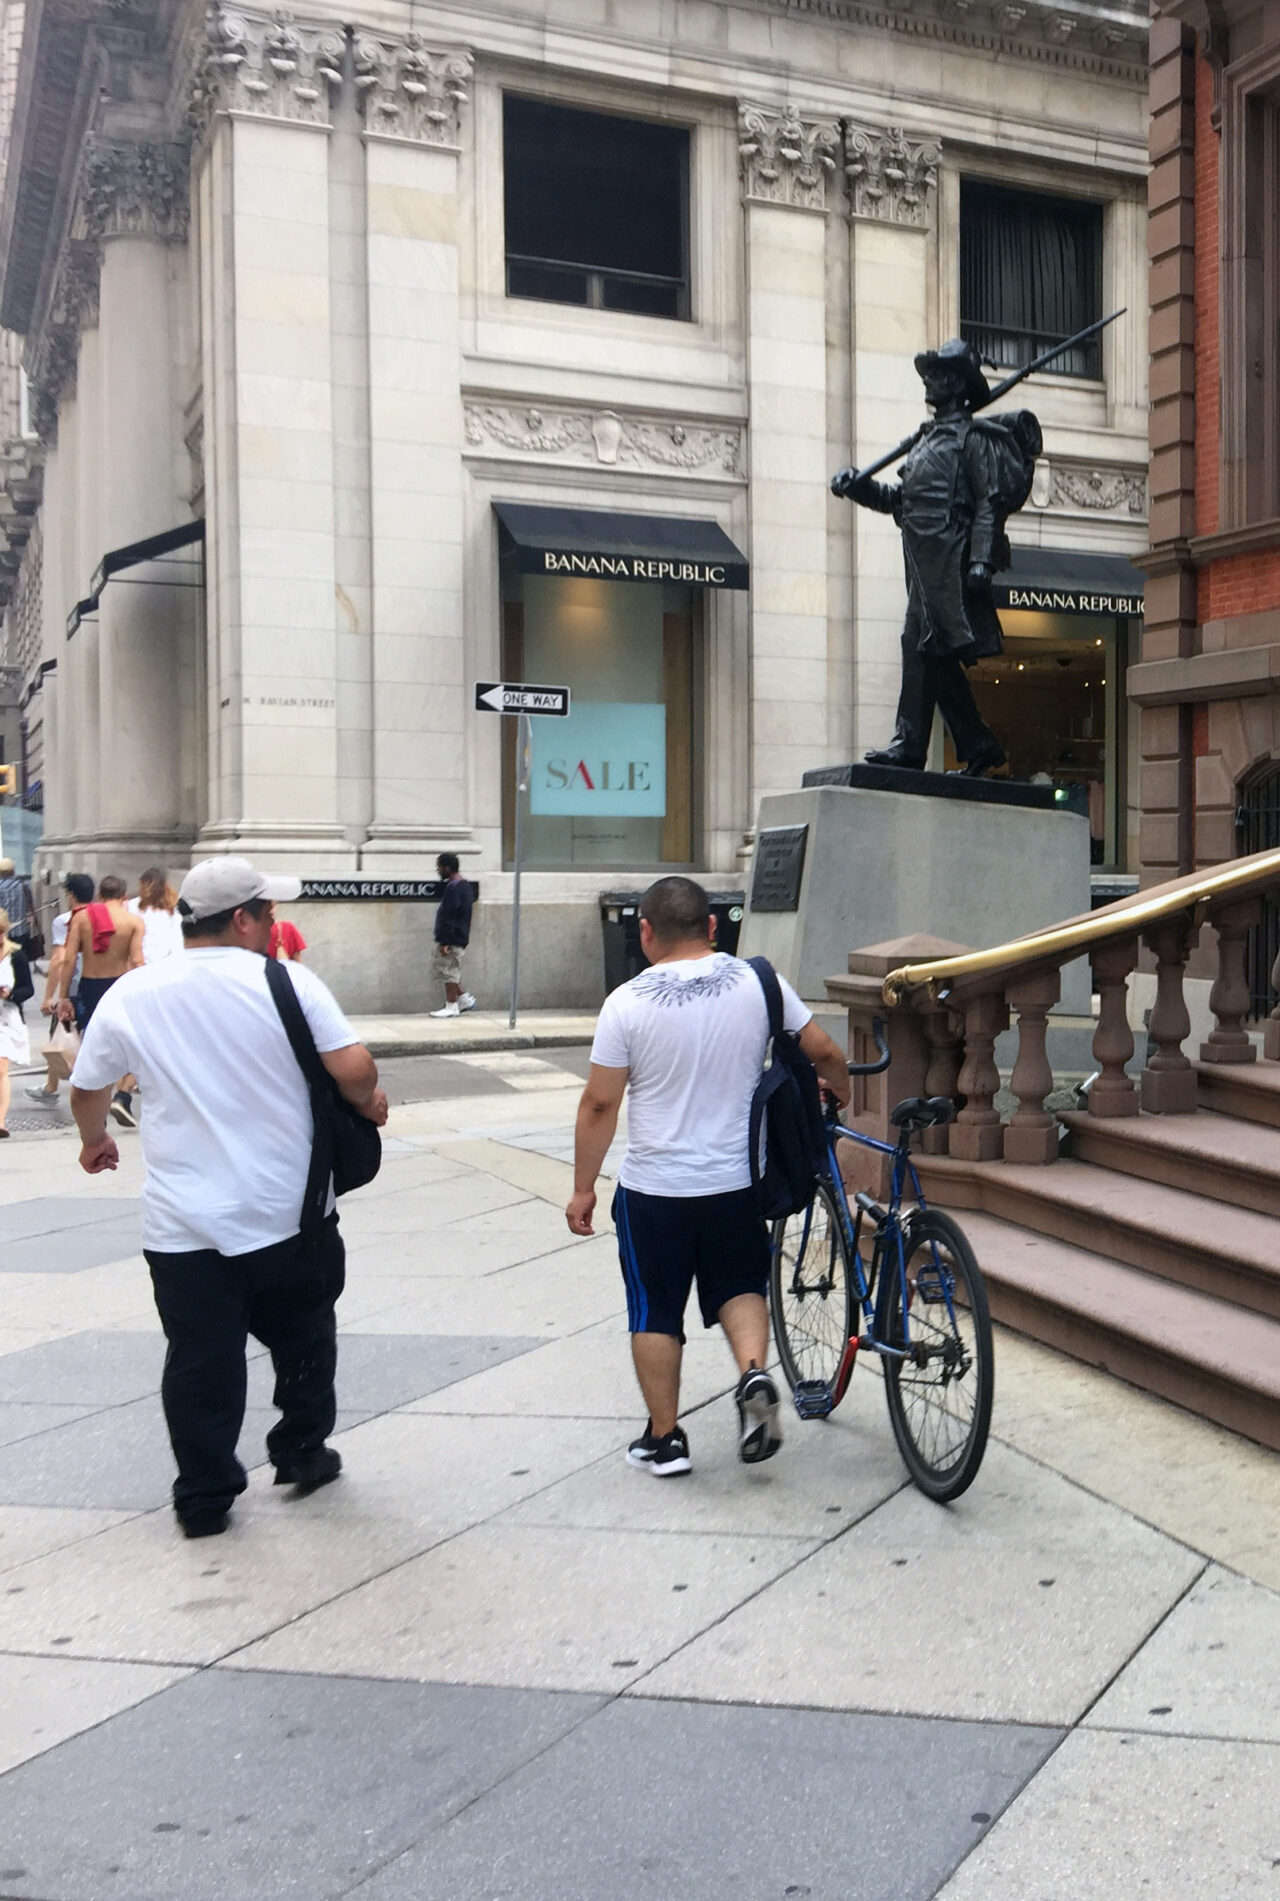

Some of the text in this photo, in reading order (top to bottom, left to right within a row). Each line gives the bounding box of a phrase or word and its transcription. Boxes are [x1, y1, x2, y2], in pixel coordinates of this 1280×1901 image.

[544, 552, 726, 584] BANANA REPUBLIC
[1009, 589, 1076, 610] BANANA
[503, 692, 559, 707] ONE WAY
[546, 758, 651, 791] SALE
[301, 883, 436, 897] ANANA REPUBLIC
